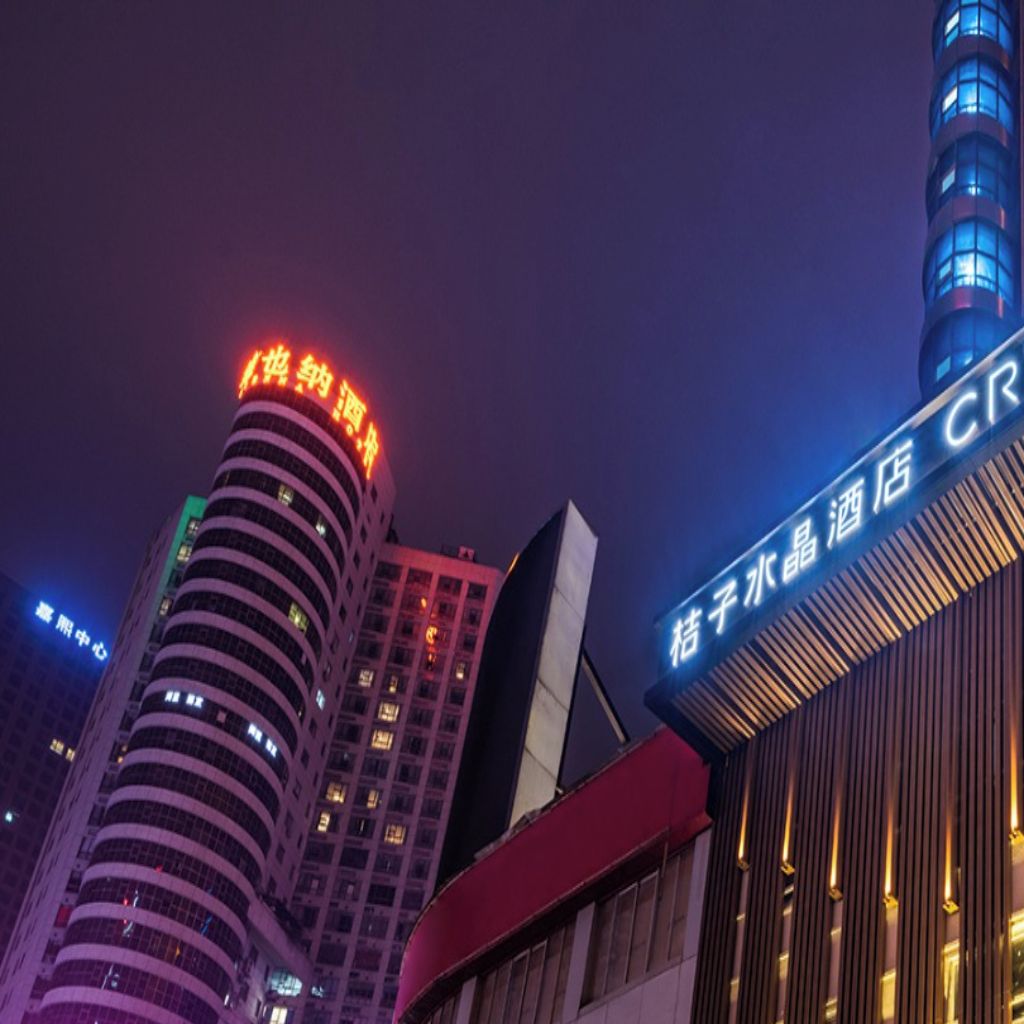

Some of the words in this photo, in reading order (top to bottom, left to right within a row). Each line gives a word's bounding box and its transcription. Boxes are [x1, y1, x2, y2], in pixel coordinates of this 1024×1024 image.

[239, 344, 379, 480] 也纳酒店
[669, 441, 914, 668] 桔子水晶酒店
